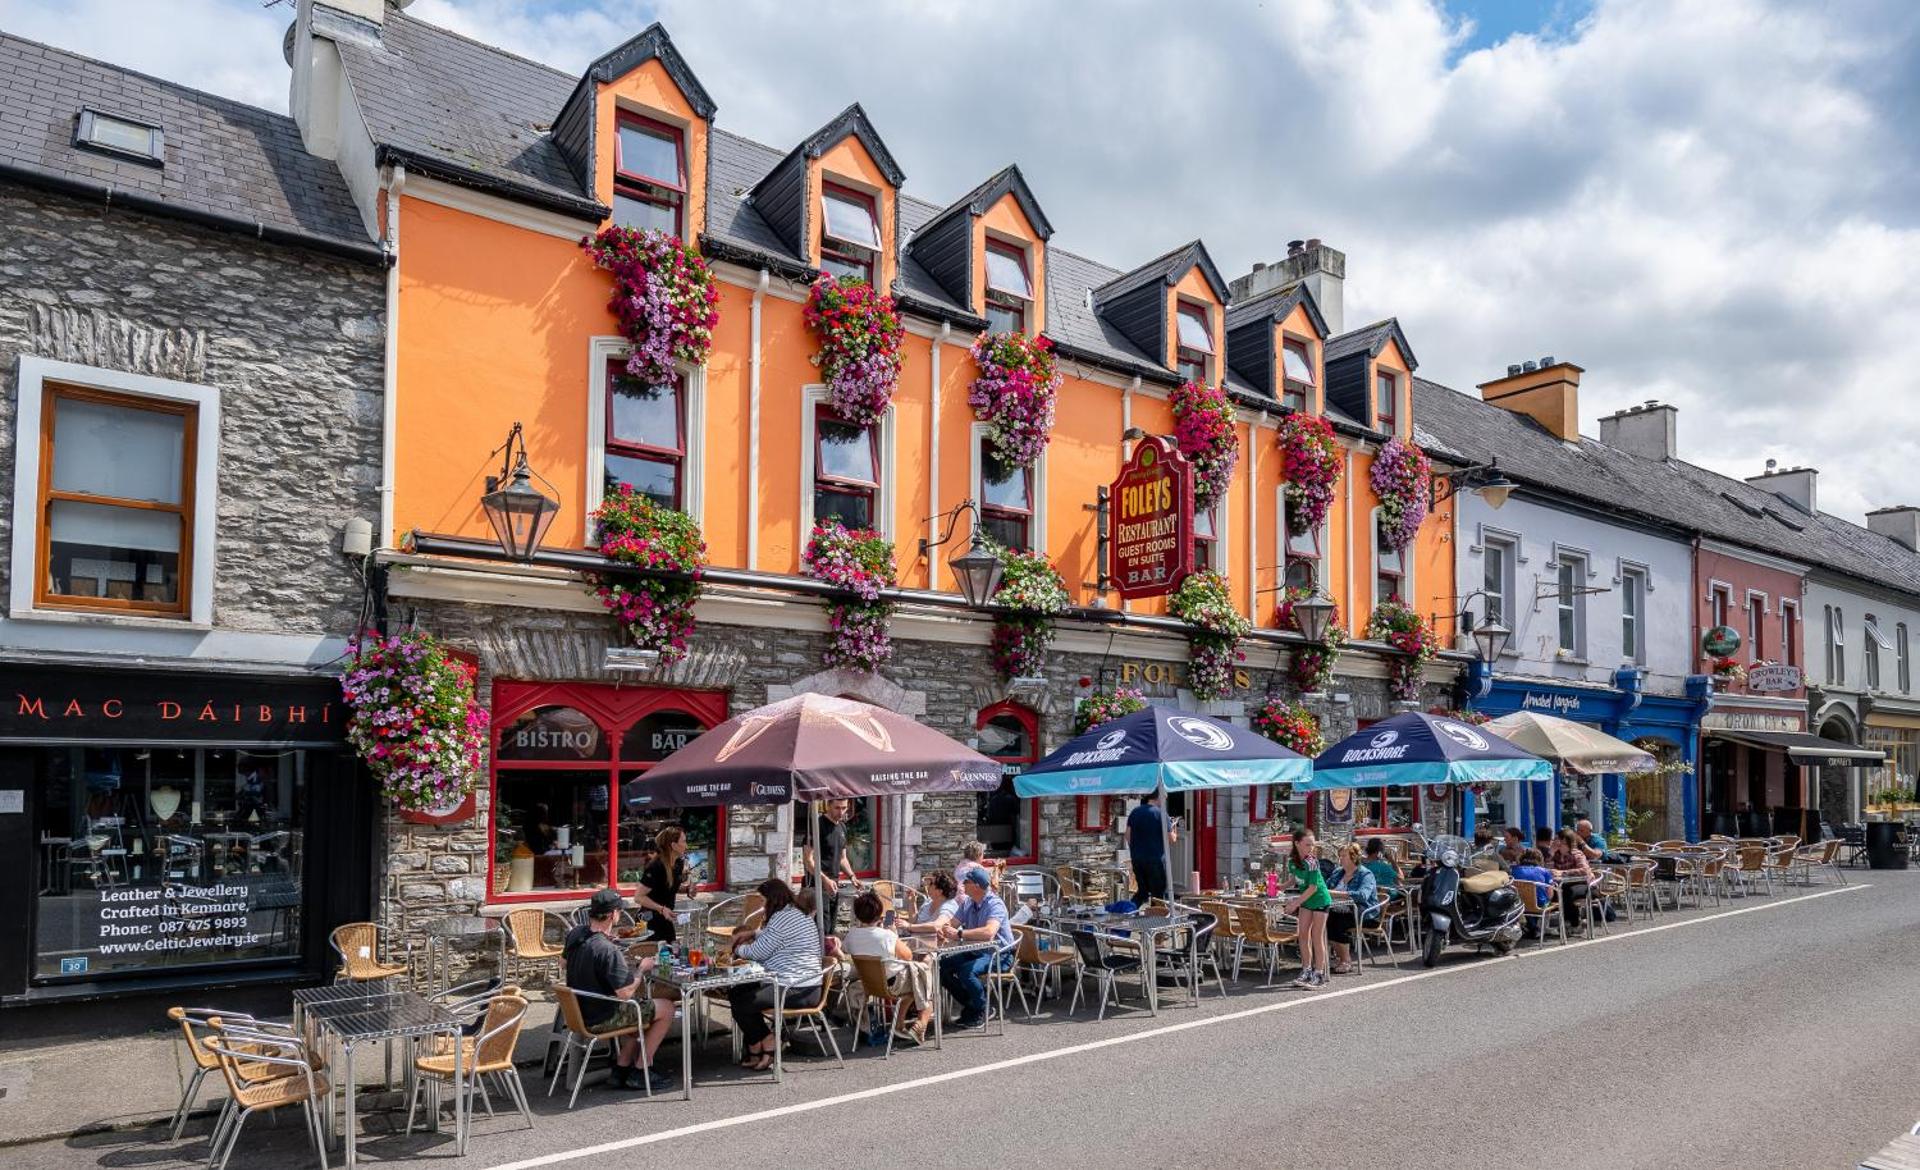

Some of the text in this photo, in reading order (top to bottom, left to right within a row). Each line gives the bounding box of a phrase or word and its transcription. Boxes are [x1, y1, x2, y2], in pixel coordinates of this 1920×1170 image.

[1122, 476, 1171, 518] FOLEYS
[1118, 513, 1177, 544] RESTAURANT
[1118, 537, 1176, 558] GUEST ROOMS
[1128, 552, 1165, 566] EN SUITE
[1128, 567, 1166, 583] BAR
[1122, 662, 1250, 689] FOLS
[1766, 678, 1784, 686] BAR
[158, 699, 331, 723] DÁIBHÍ
[516, 731, 591, 748] BISTRO
[652, 733, 687, 750] BAR
[1062, 745, 1131, 766] ROCKSHORE
[1341, 744, 1410, 763] ROCKSHORE
[870, 771, 928, 782] RAISING THE BAR
[960, 772, 998, 782] GUINNESS
[101, 884, 248, 902] Leather & Jewellery
[101, 902, 250, 919] Crafted in Kenmare,
[100, 917, 248, 937] Phone: 087 475 9893
[100, 932, 259, 954] www.CelticJewelry.ie
